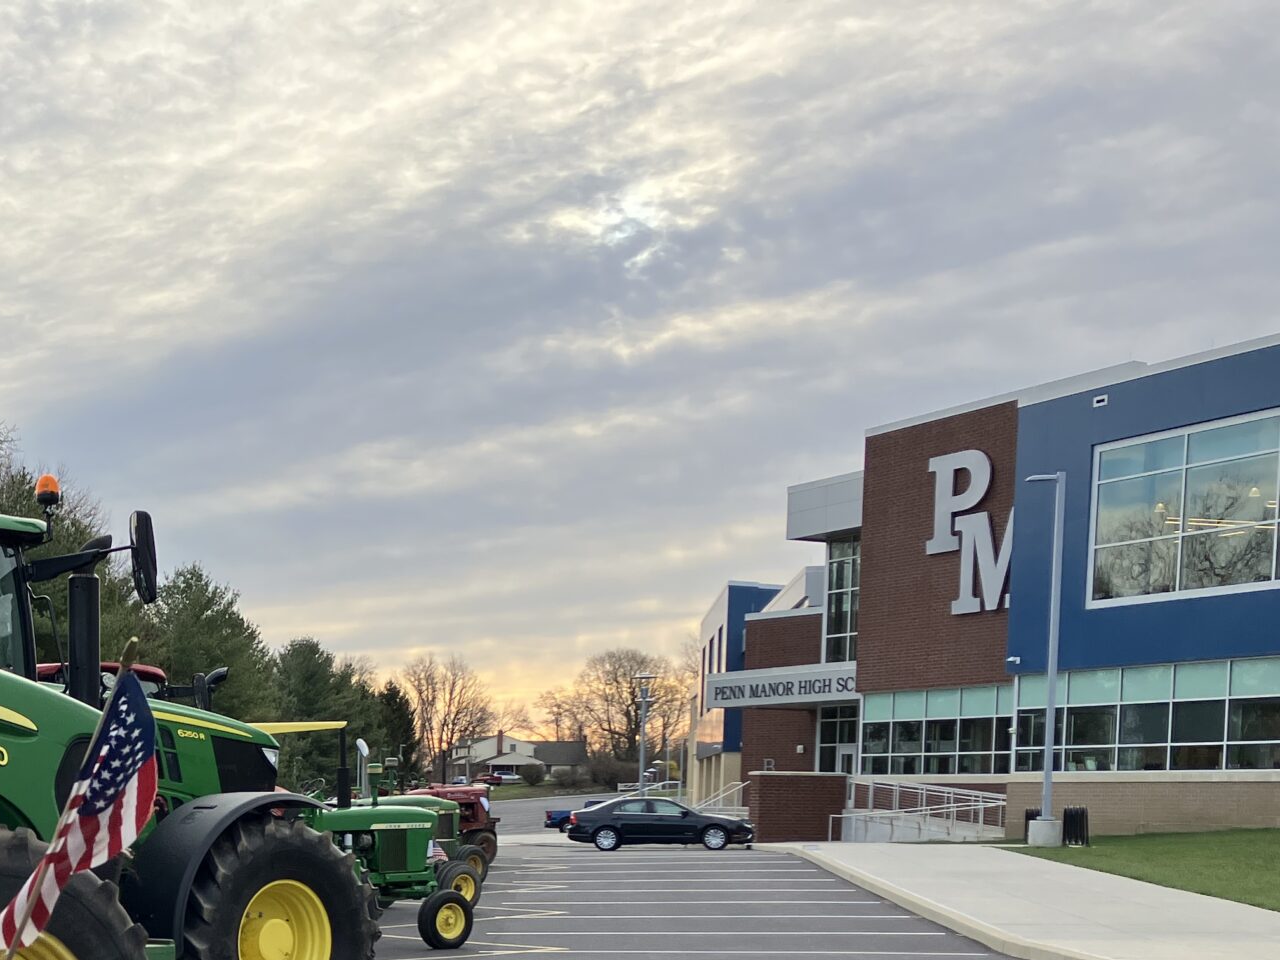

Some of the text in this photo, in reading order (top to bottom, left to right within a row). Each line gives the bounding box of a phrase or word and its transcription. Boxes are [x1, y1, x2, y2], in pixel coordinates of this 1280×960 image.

[714, 676, 856, 701] PENN MANOR HIGH SC
